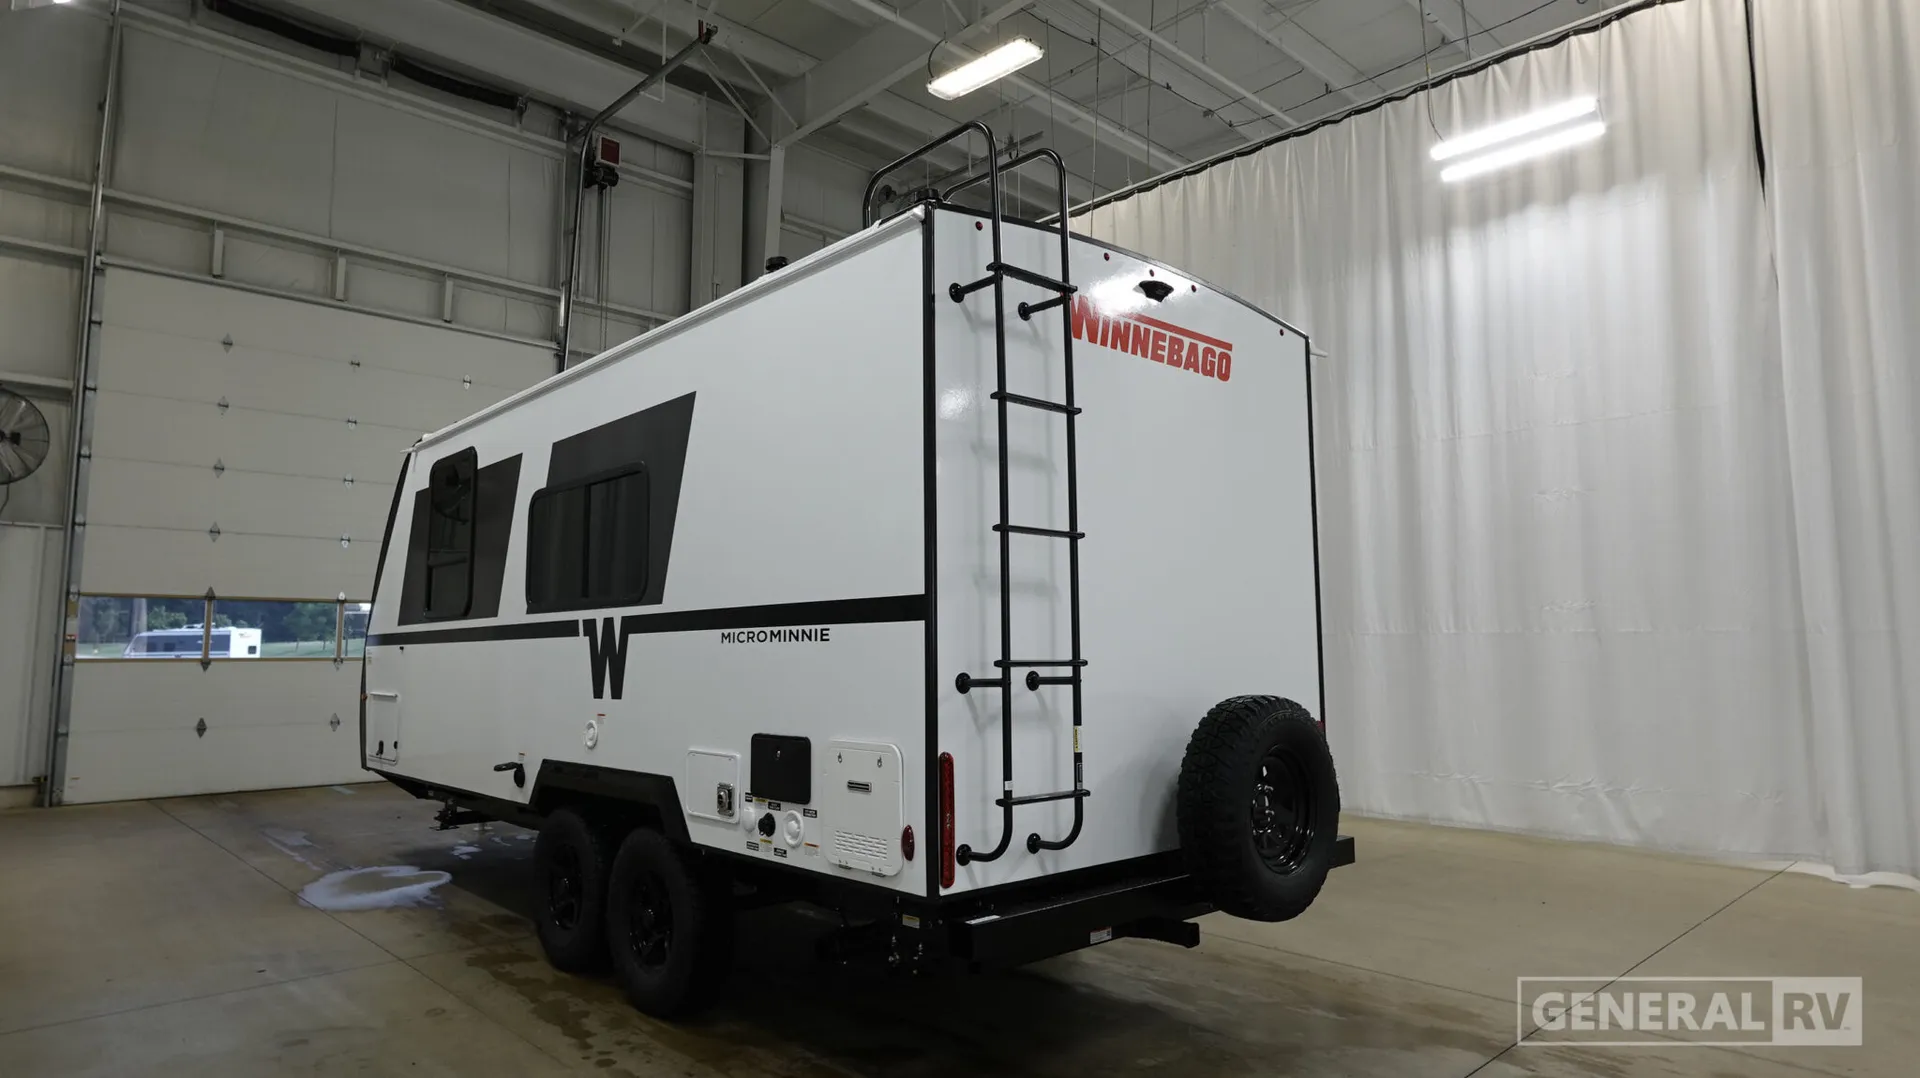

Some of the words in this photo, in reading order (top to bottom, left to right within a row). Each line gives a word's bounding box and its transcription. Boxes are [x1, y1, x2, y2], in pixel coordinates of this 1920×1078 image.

[1070, 295, 1232, 382] WINNEBAGO
[582, 617, 629, 700] W
[720, 628, 831, 644] MICROMINNIE
